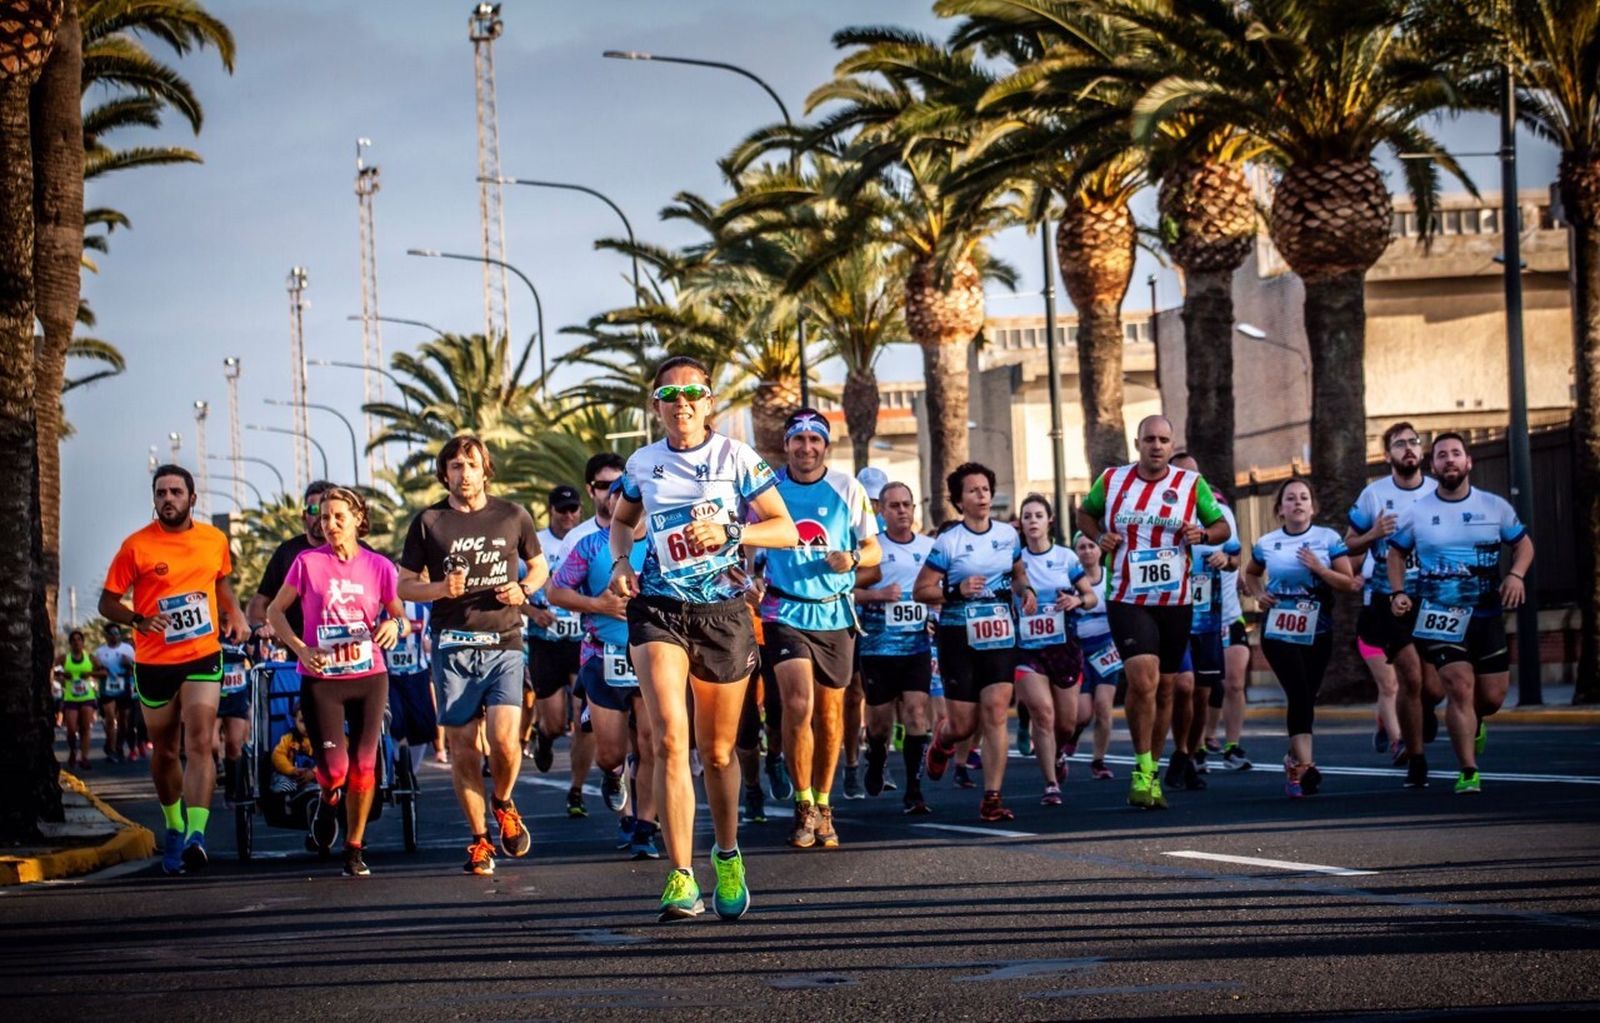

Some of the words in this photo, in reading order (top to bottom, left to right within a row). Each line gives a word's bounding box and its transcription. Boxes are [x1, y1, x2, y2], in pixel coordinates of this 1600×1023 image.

[692, 505, 716, 517] KIA
[1116, 514, 1144, 524] Sierra
[450, 536, 485, 553] NOC
[475, 551, 500, 564] TUR
[490, 560, 507, 576] NA
[1139, 563, 1171, 583] 786
[171, 607, 202, 630] 331
[893, 605, 922, 622] 950
[557, 621, 578, 634] 611
[973, 619, 1009, 639] 1091
[1028, 618, 1054, 636] 198
[1275, 613, 1307, 633] 408
[1425, 613, 1459, 633] 832
[332, 641, 360, 662] 116
[393, 653, 412, 665] 924
